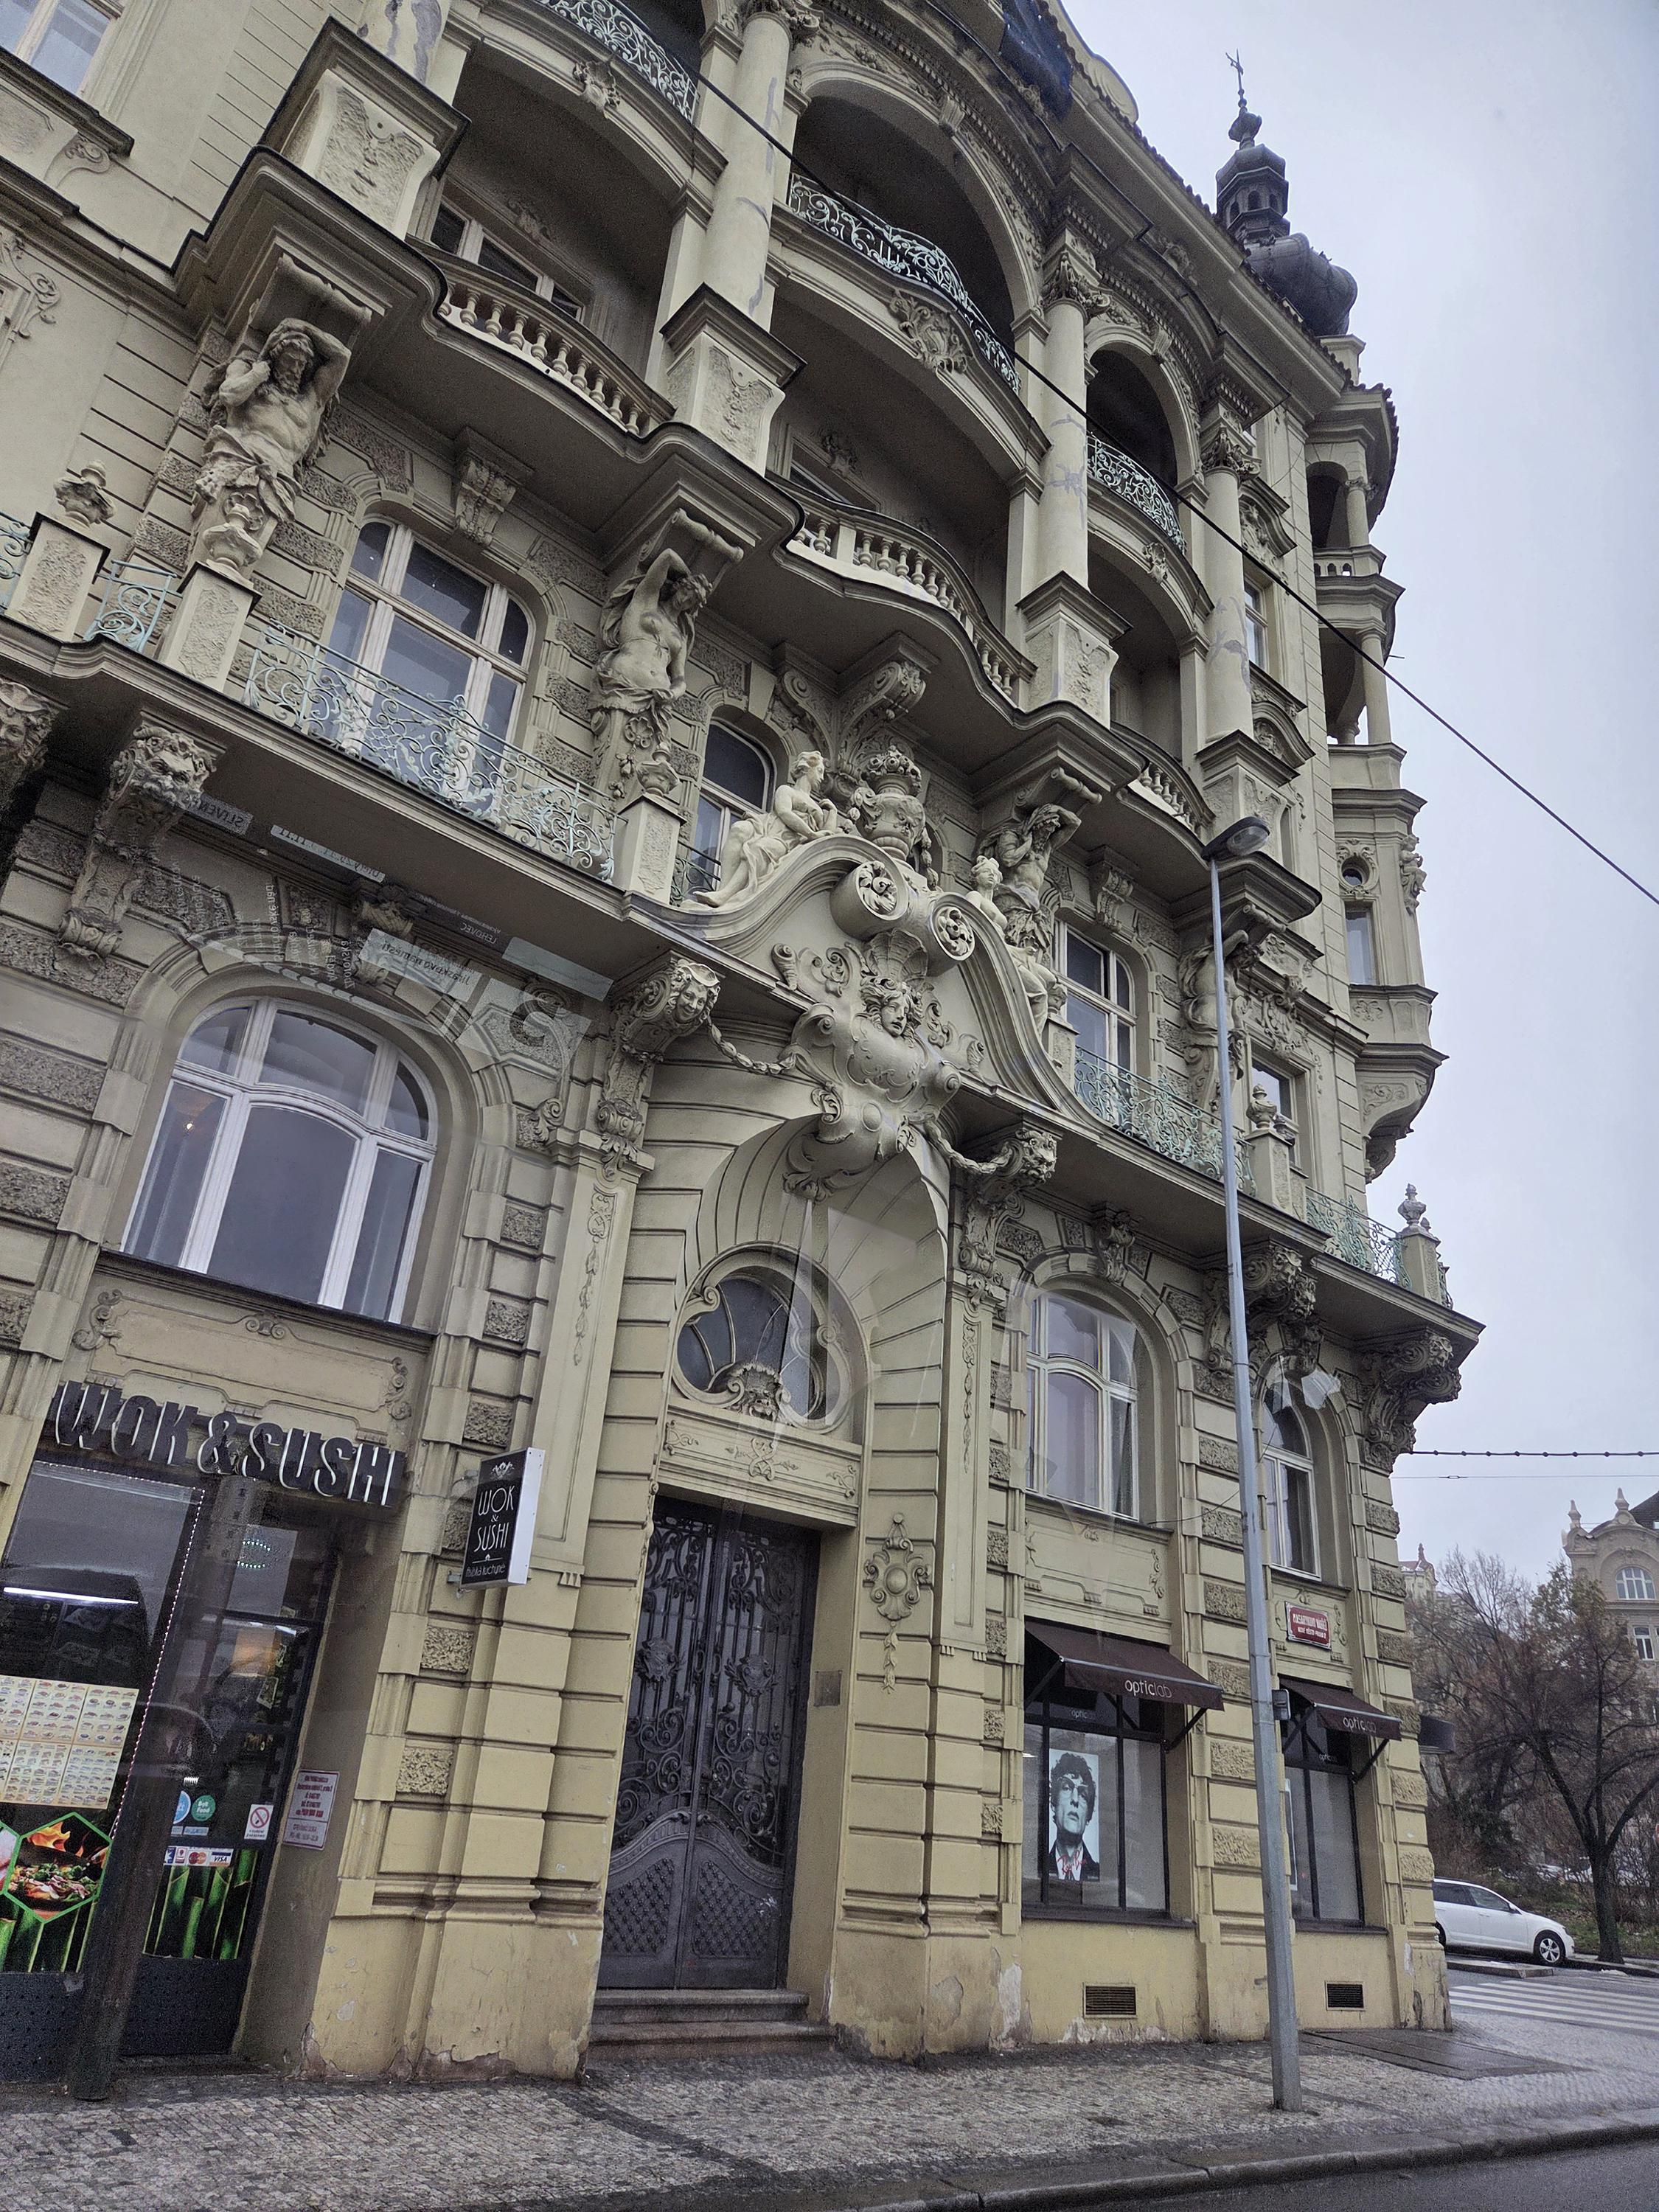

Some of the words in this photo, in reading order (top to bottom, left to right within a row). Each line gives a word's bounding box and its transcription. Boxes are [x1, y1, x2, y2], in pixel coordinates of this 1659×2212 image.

[55, 1380, 200, 1466] WOK
[242, 1422, 405, 1507] SUSHI
[478, 1485, 515, 1516] WOK
[490, 1514, 499, 1523] &
[473, 1522, 509, 1552] SUSHI
[1124, 1680, 1172, 1698] opticlab
[1071, 1708, 1096, 1721] optic
